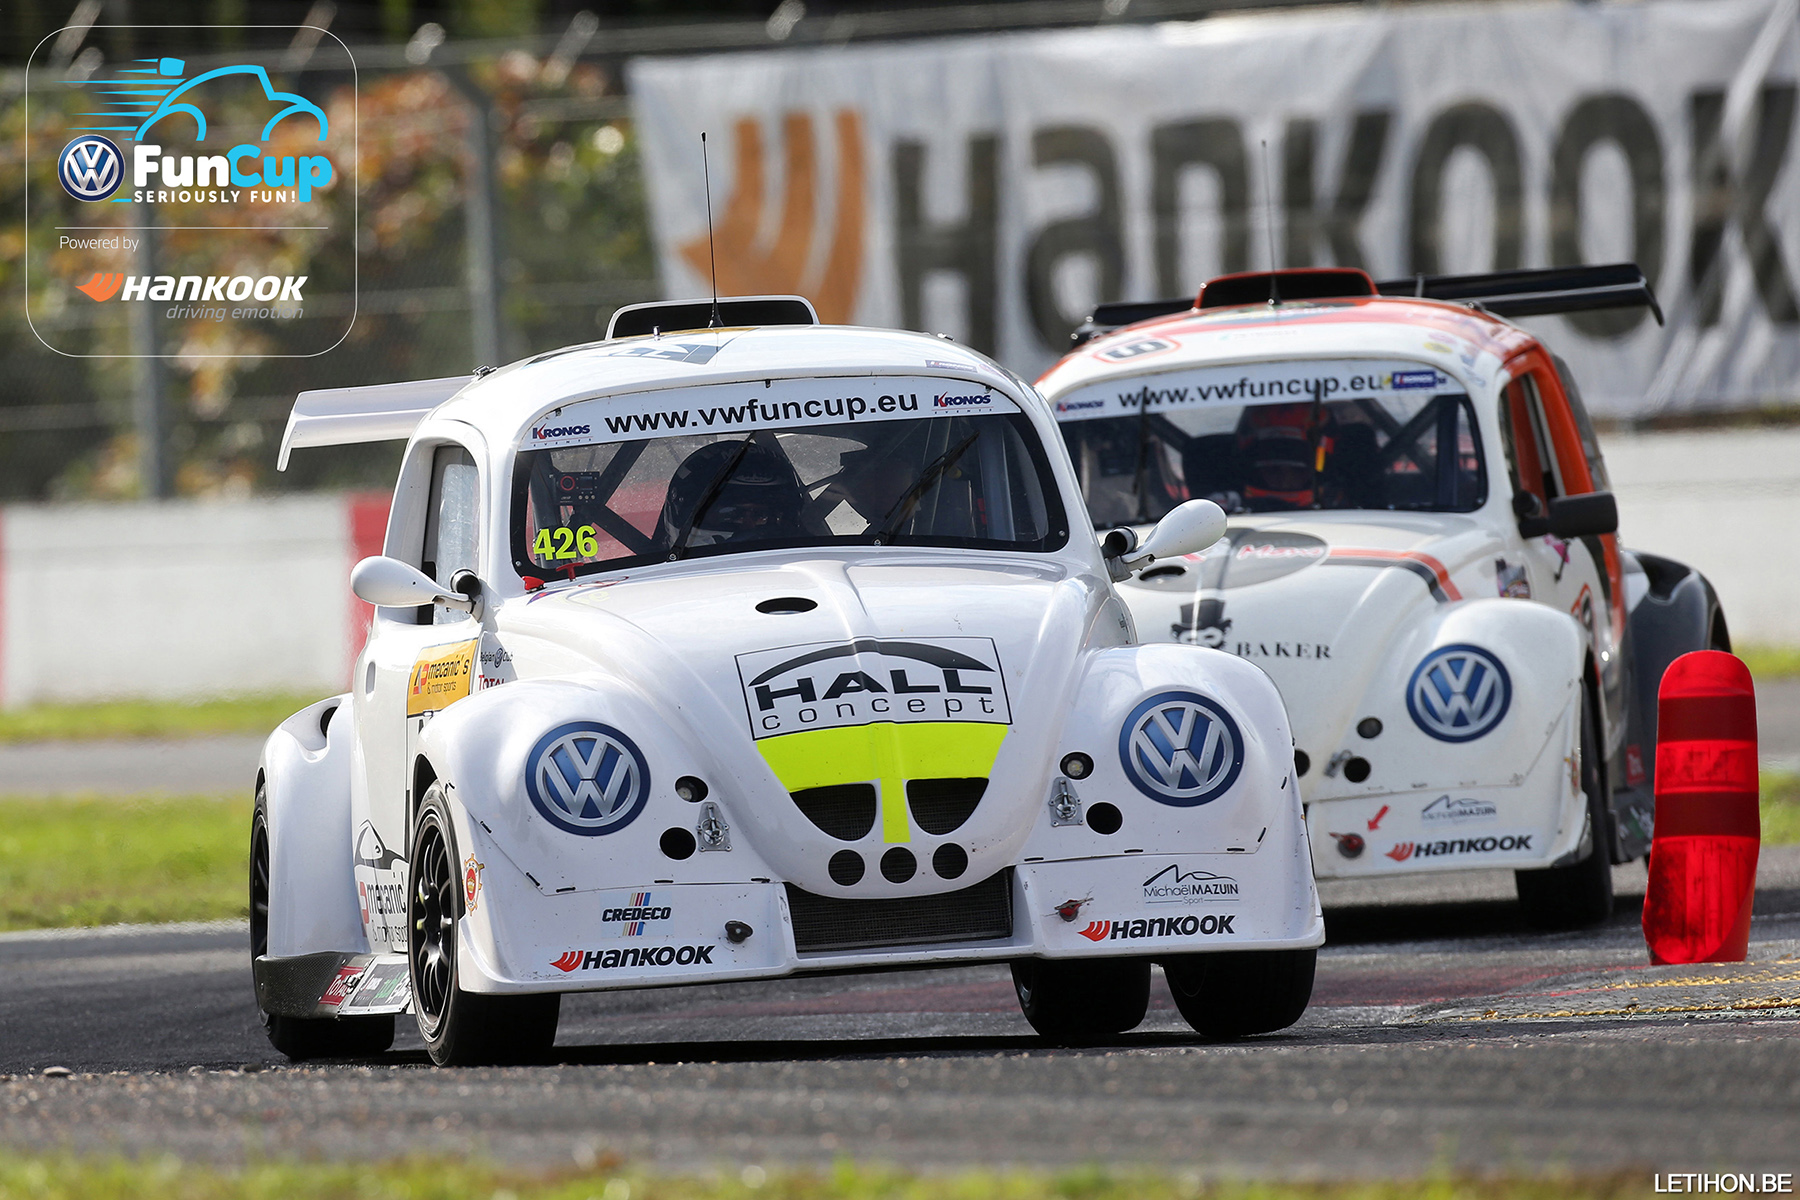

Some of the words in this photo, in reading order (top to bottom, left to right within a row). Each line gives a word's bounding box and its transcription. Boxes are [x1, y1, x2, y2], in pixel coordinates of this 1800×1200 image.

[935, 392, 991, 407] KRONOS
[1118, 376, 1385, 408] www.vwfuncup.eu
[604, 393, 919, 434] www.vwfuncup.eu
[532, 423, 591, 439] KRONOS
[533, 525, 599, 560] 426
[1237, 642, 1332, 659] BAKER
[755, 669, 993, 712] HALL
[761, 696, 995, 731] concept
[1183, 897, 1204, 906] Sport
[602, 906, 671, 922] CREDECO
